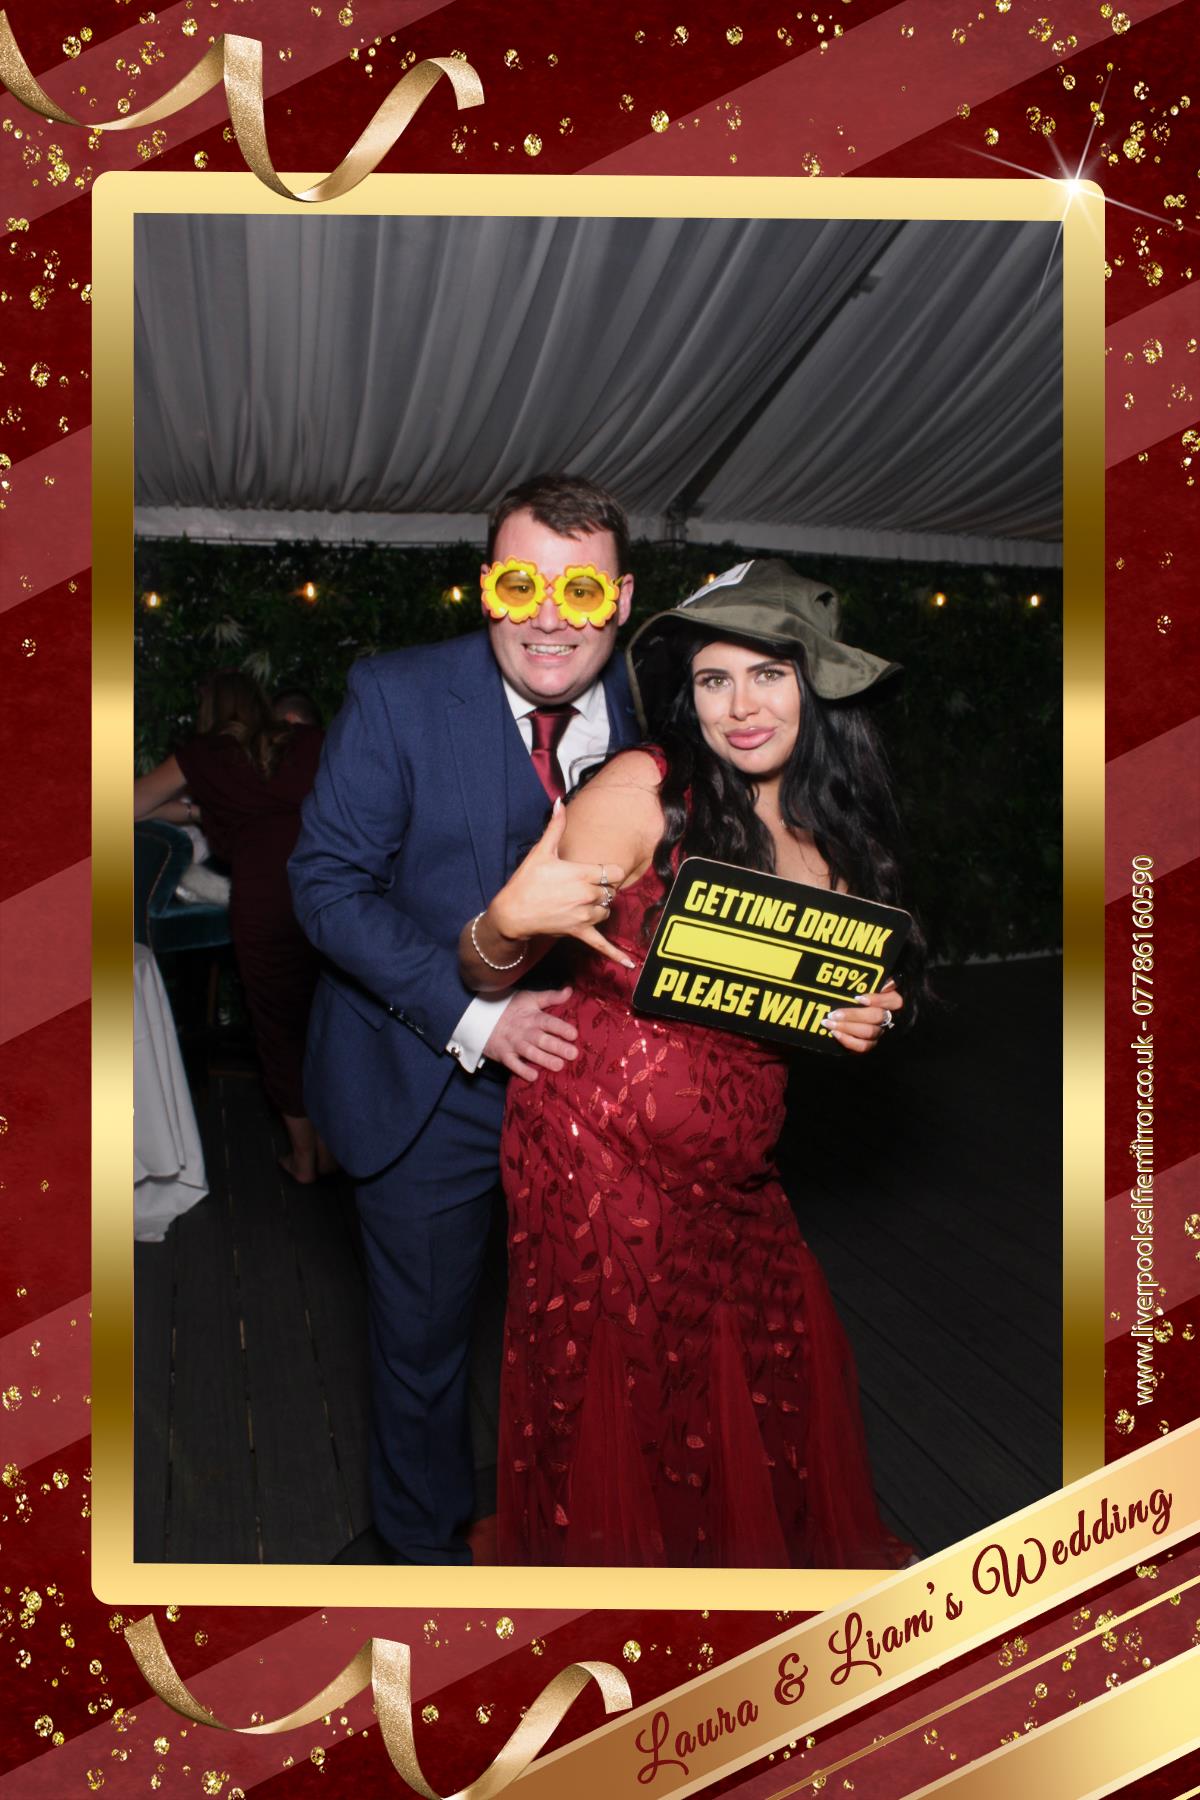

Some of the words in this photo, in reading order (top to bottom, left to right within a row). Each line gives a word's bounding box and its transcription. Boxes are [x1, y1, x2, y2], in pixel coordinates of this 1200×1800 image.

[684, 880, 796, 933] GETTING
[795, 907, 893, 957] DRUNK
[653, 967, 758, 1017] PLEASE
[815, 962, 868, 994] 69%
